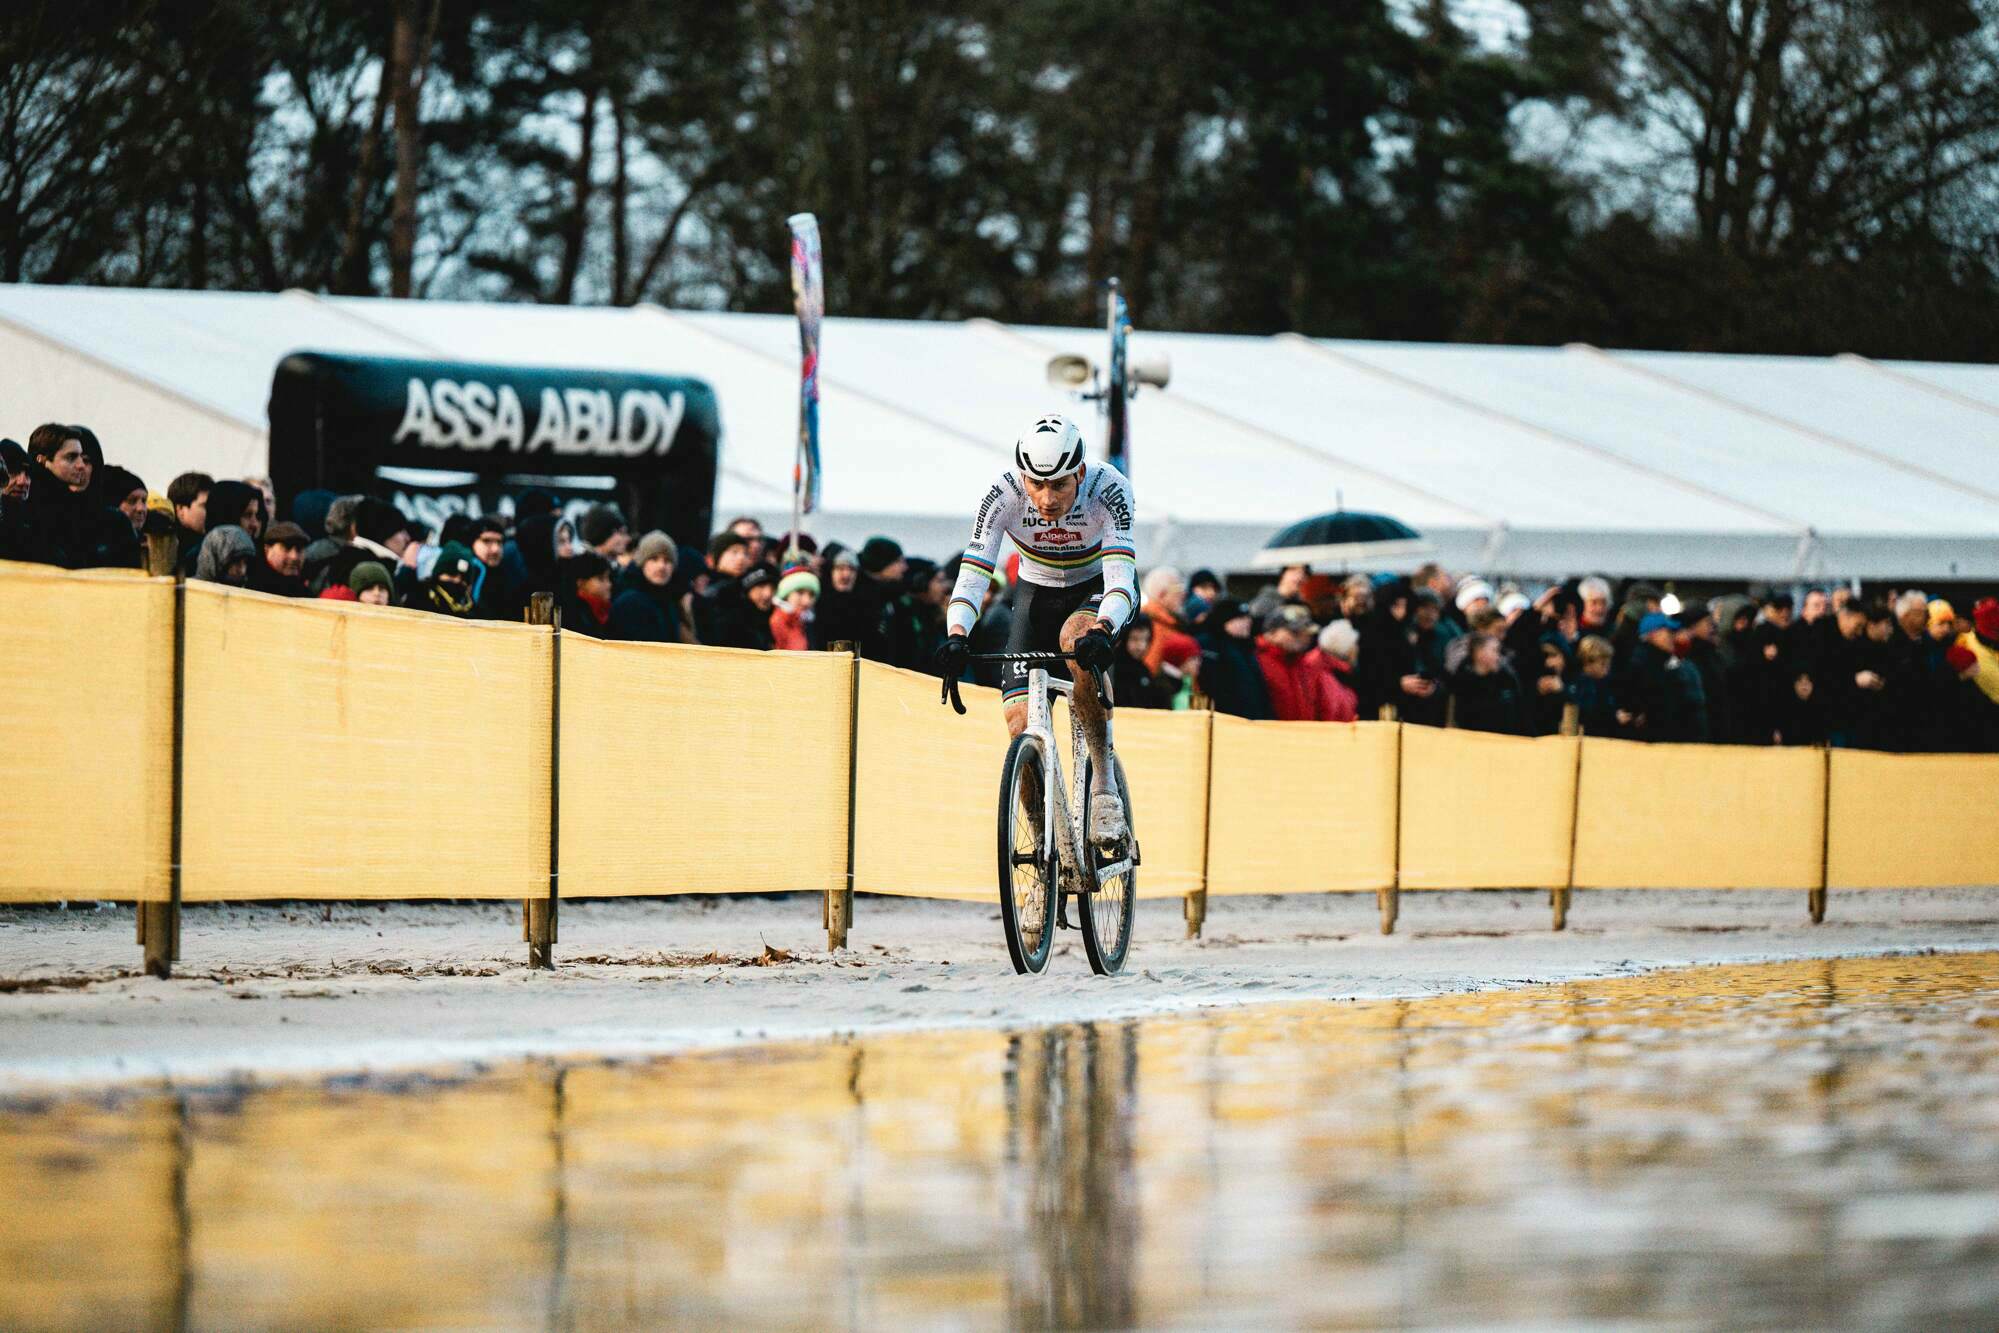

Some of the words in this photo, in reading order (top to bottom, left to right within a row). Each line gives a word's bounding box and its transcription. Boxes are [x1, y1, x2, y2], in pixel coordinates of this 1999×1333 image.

[393, 376, 525, 452] ASSA
[526, 386, 686, 457] ABLOY
[974, 484, 1004, 540] deceuninck
[1100, 482, 1131, 531] Alpecin
[1040, 532, 1077, 541] Alpecin
